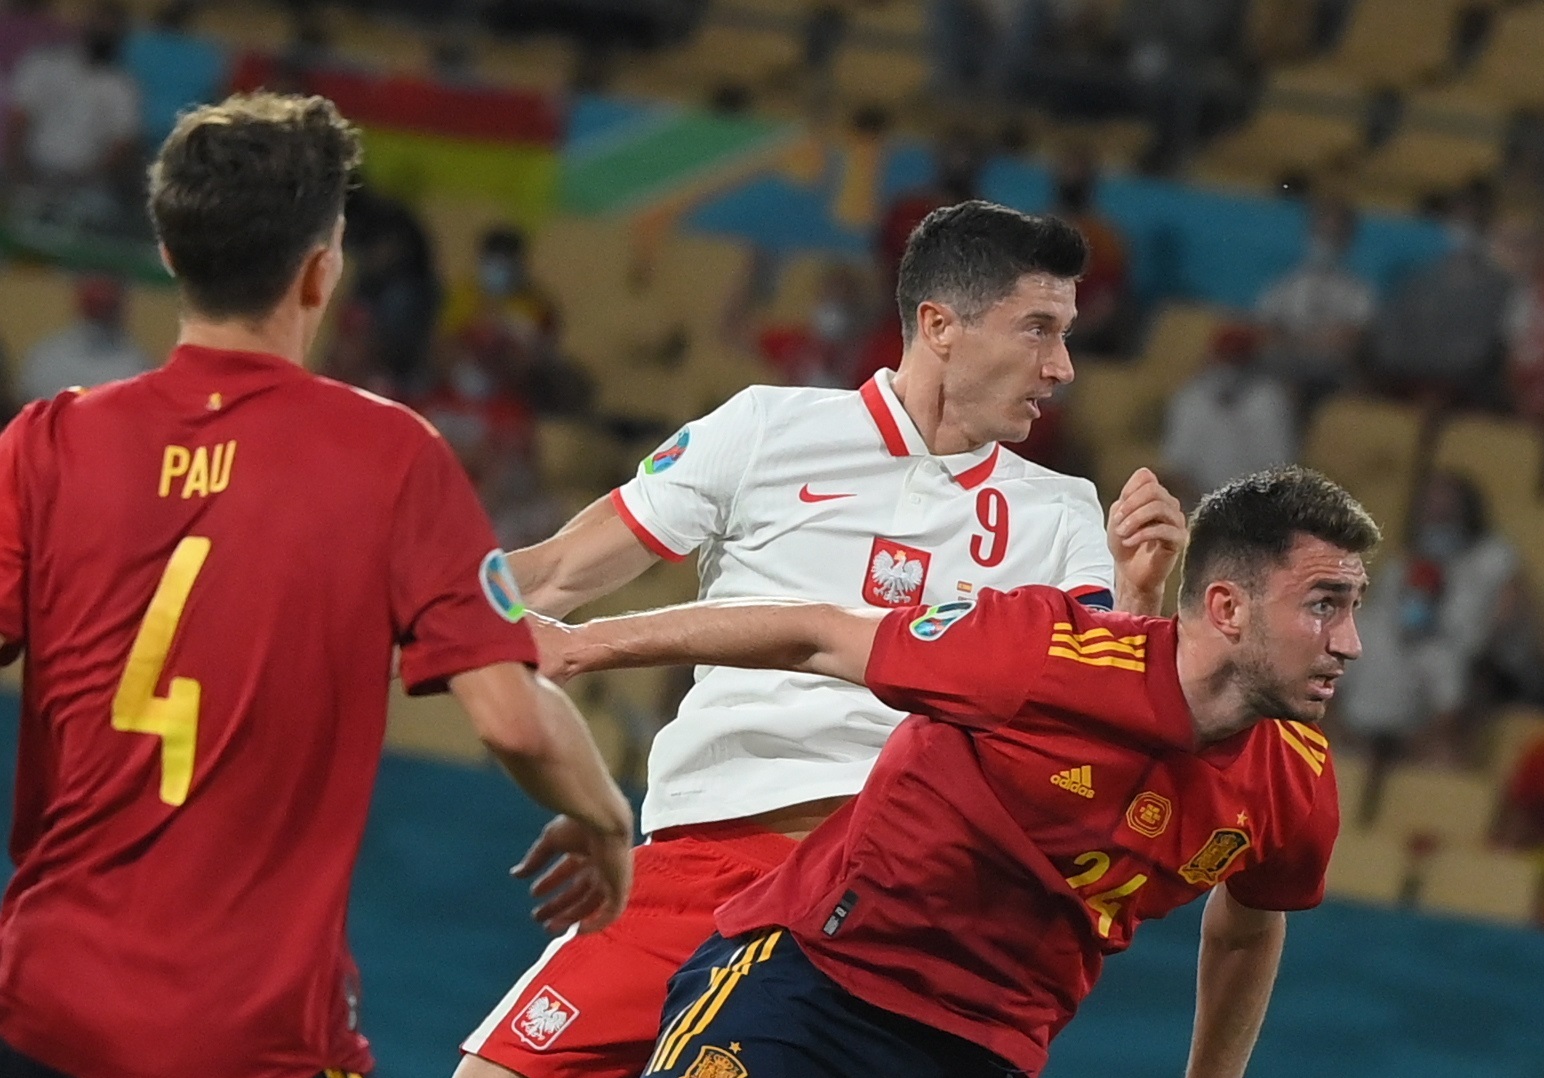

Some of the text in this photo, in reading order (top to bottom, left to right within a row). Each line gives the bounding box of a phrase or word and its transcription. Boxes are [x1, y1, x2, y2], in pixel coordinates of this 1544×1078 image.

[158, 440, 237, 499] PAU
[970, 487, 1009, 568] 9
[111, 536, 212, 807] 4
[1050, 774, 1095, 799] adidas
[1065, 851, 1148, 938] 24
